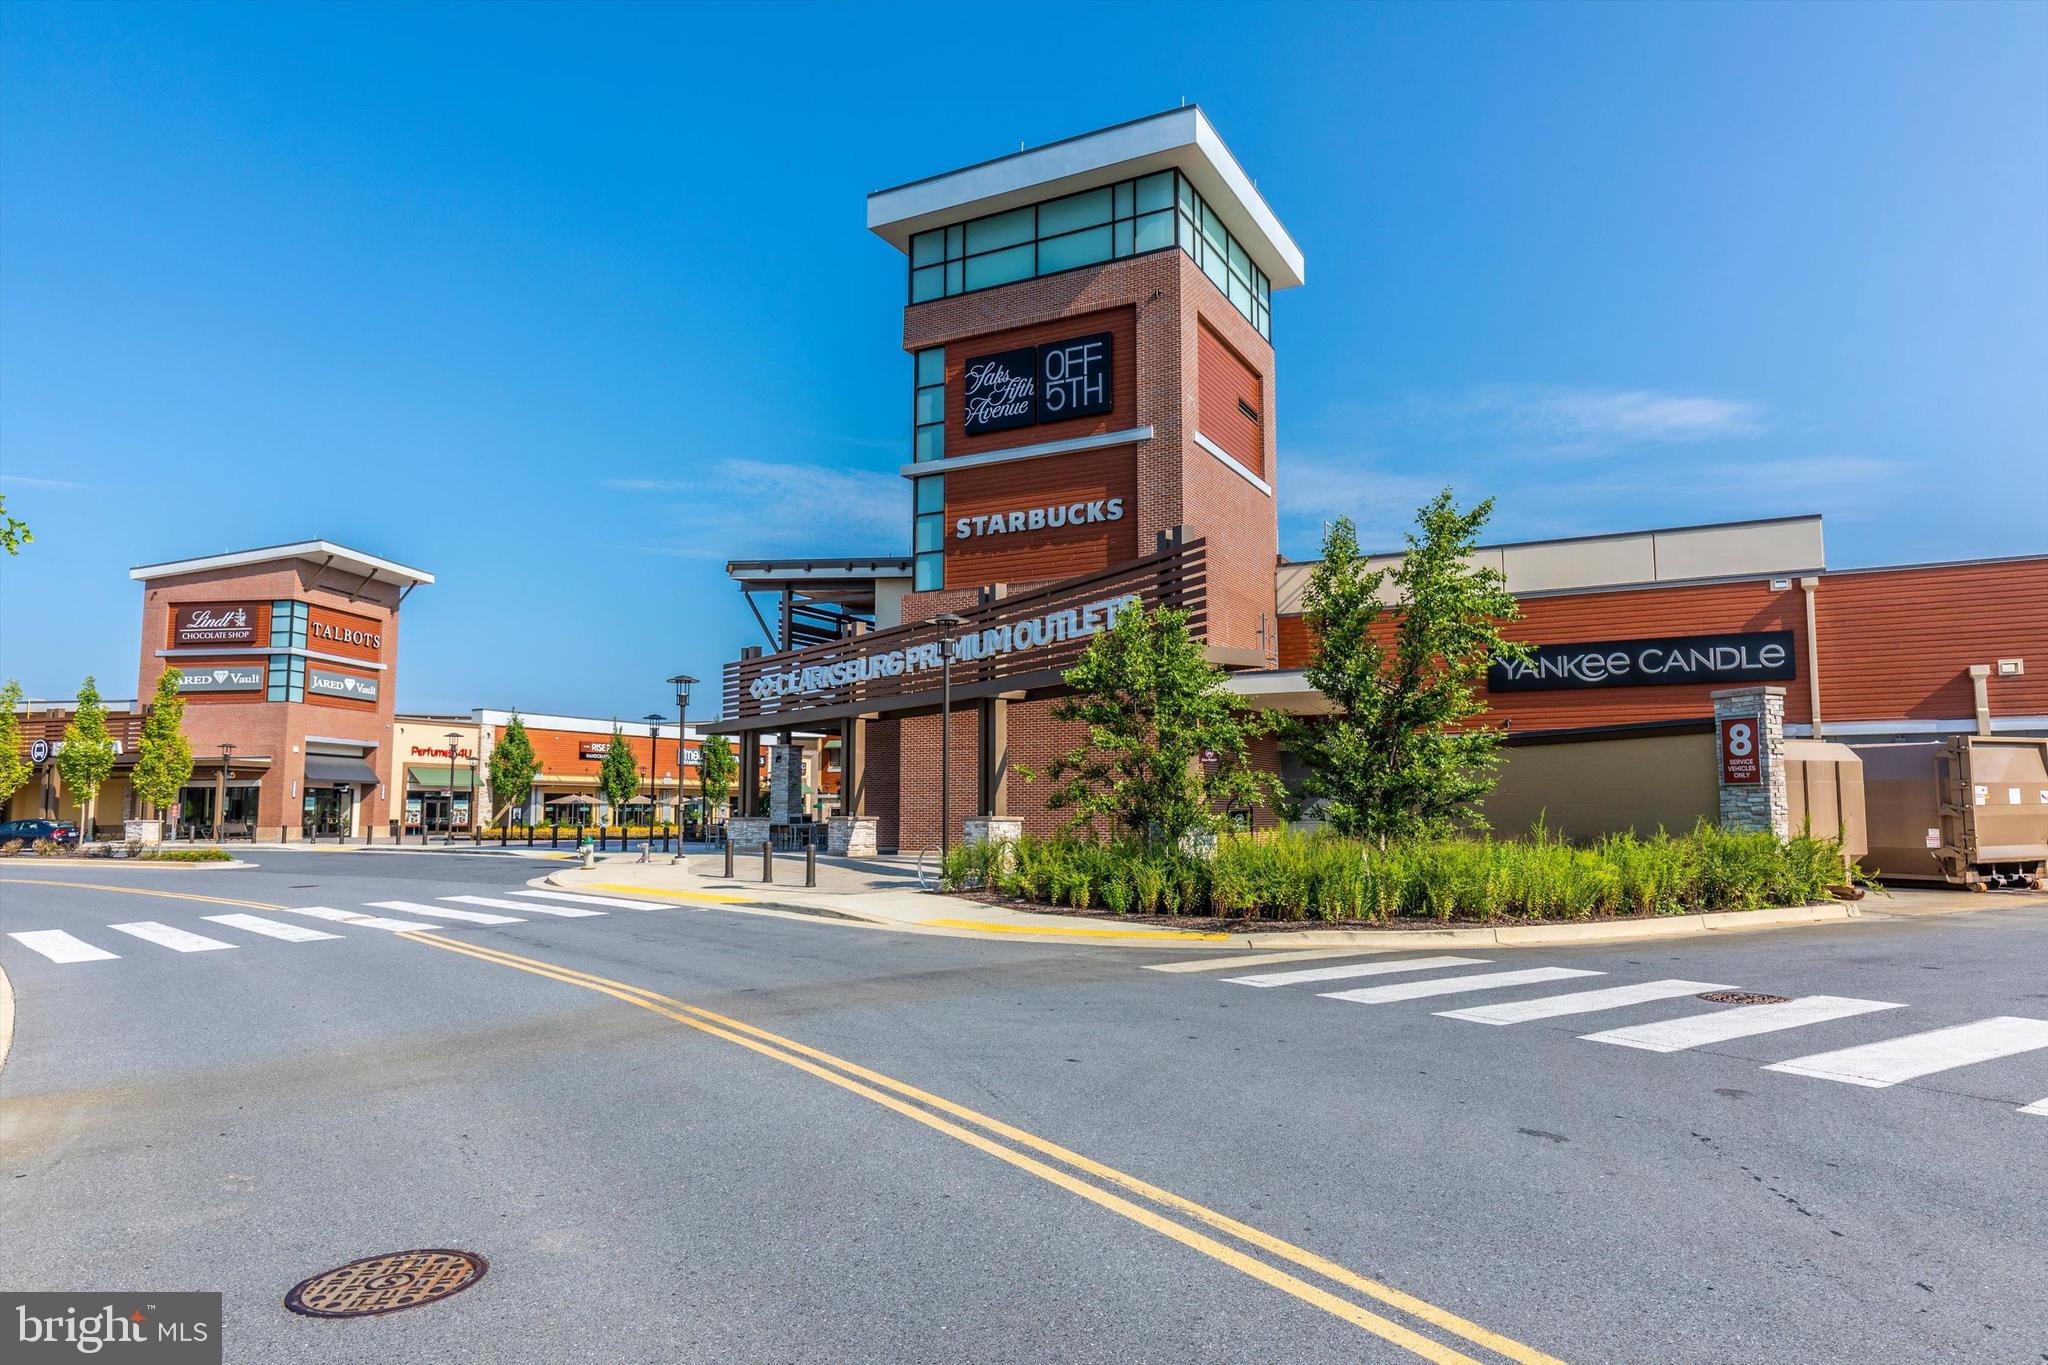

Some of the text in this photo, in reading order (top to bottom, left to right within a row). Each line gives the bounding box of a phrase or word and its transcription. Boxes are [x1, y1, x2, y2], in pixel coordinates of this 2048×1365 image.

[1046, 342, 1102, 380] OFF
[965, 362, 1010, 395] Saks
[1046, 373, 1102, 411] 5TH
[965, 398, 1029, 426] Avenue
[956, 498, 1124, 539] STARBUCKS
[187, 610, 235, 628] Lindt
[182, 631, 250, 640] CHOCOLATE SHOP
[312, 622, 380, 648] TALBOTS
[175, 673, 259, 685] ARED Vault
[312, 676, 376, 695] JARED Vault
[776, 651, 905, 696] CLARKSBURG
[592, 743, 606, 751] RISE
[1729, 723, 1752, 756] 8
